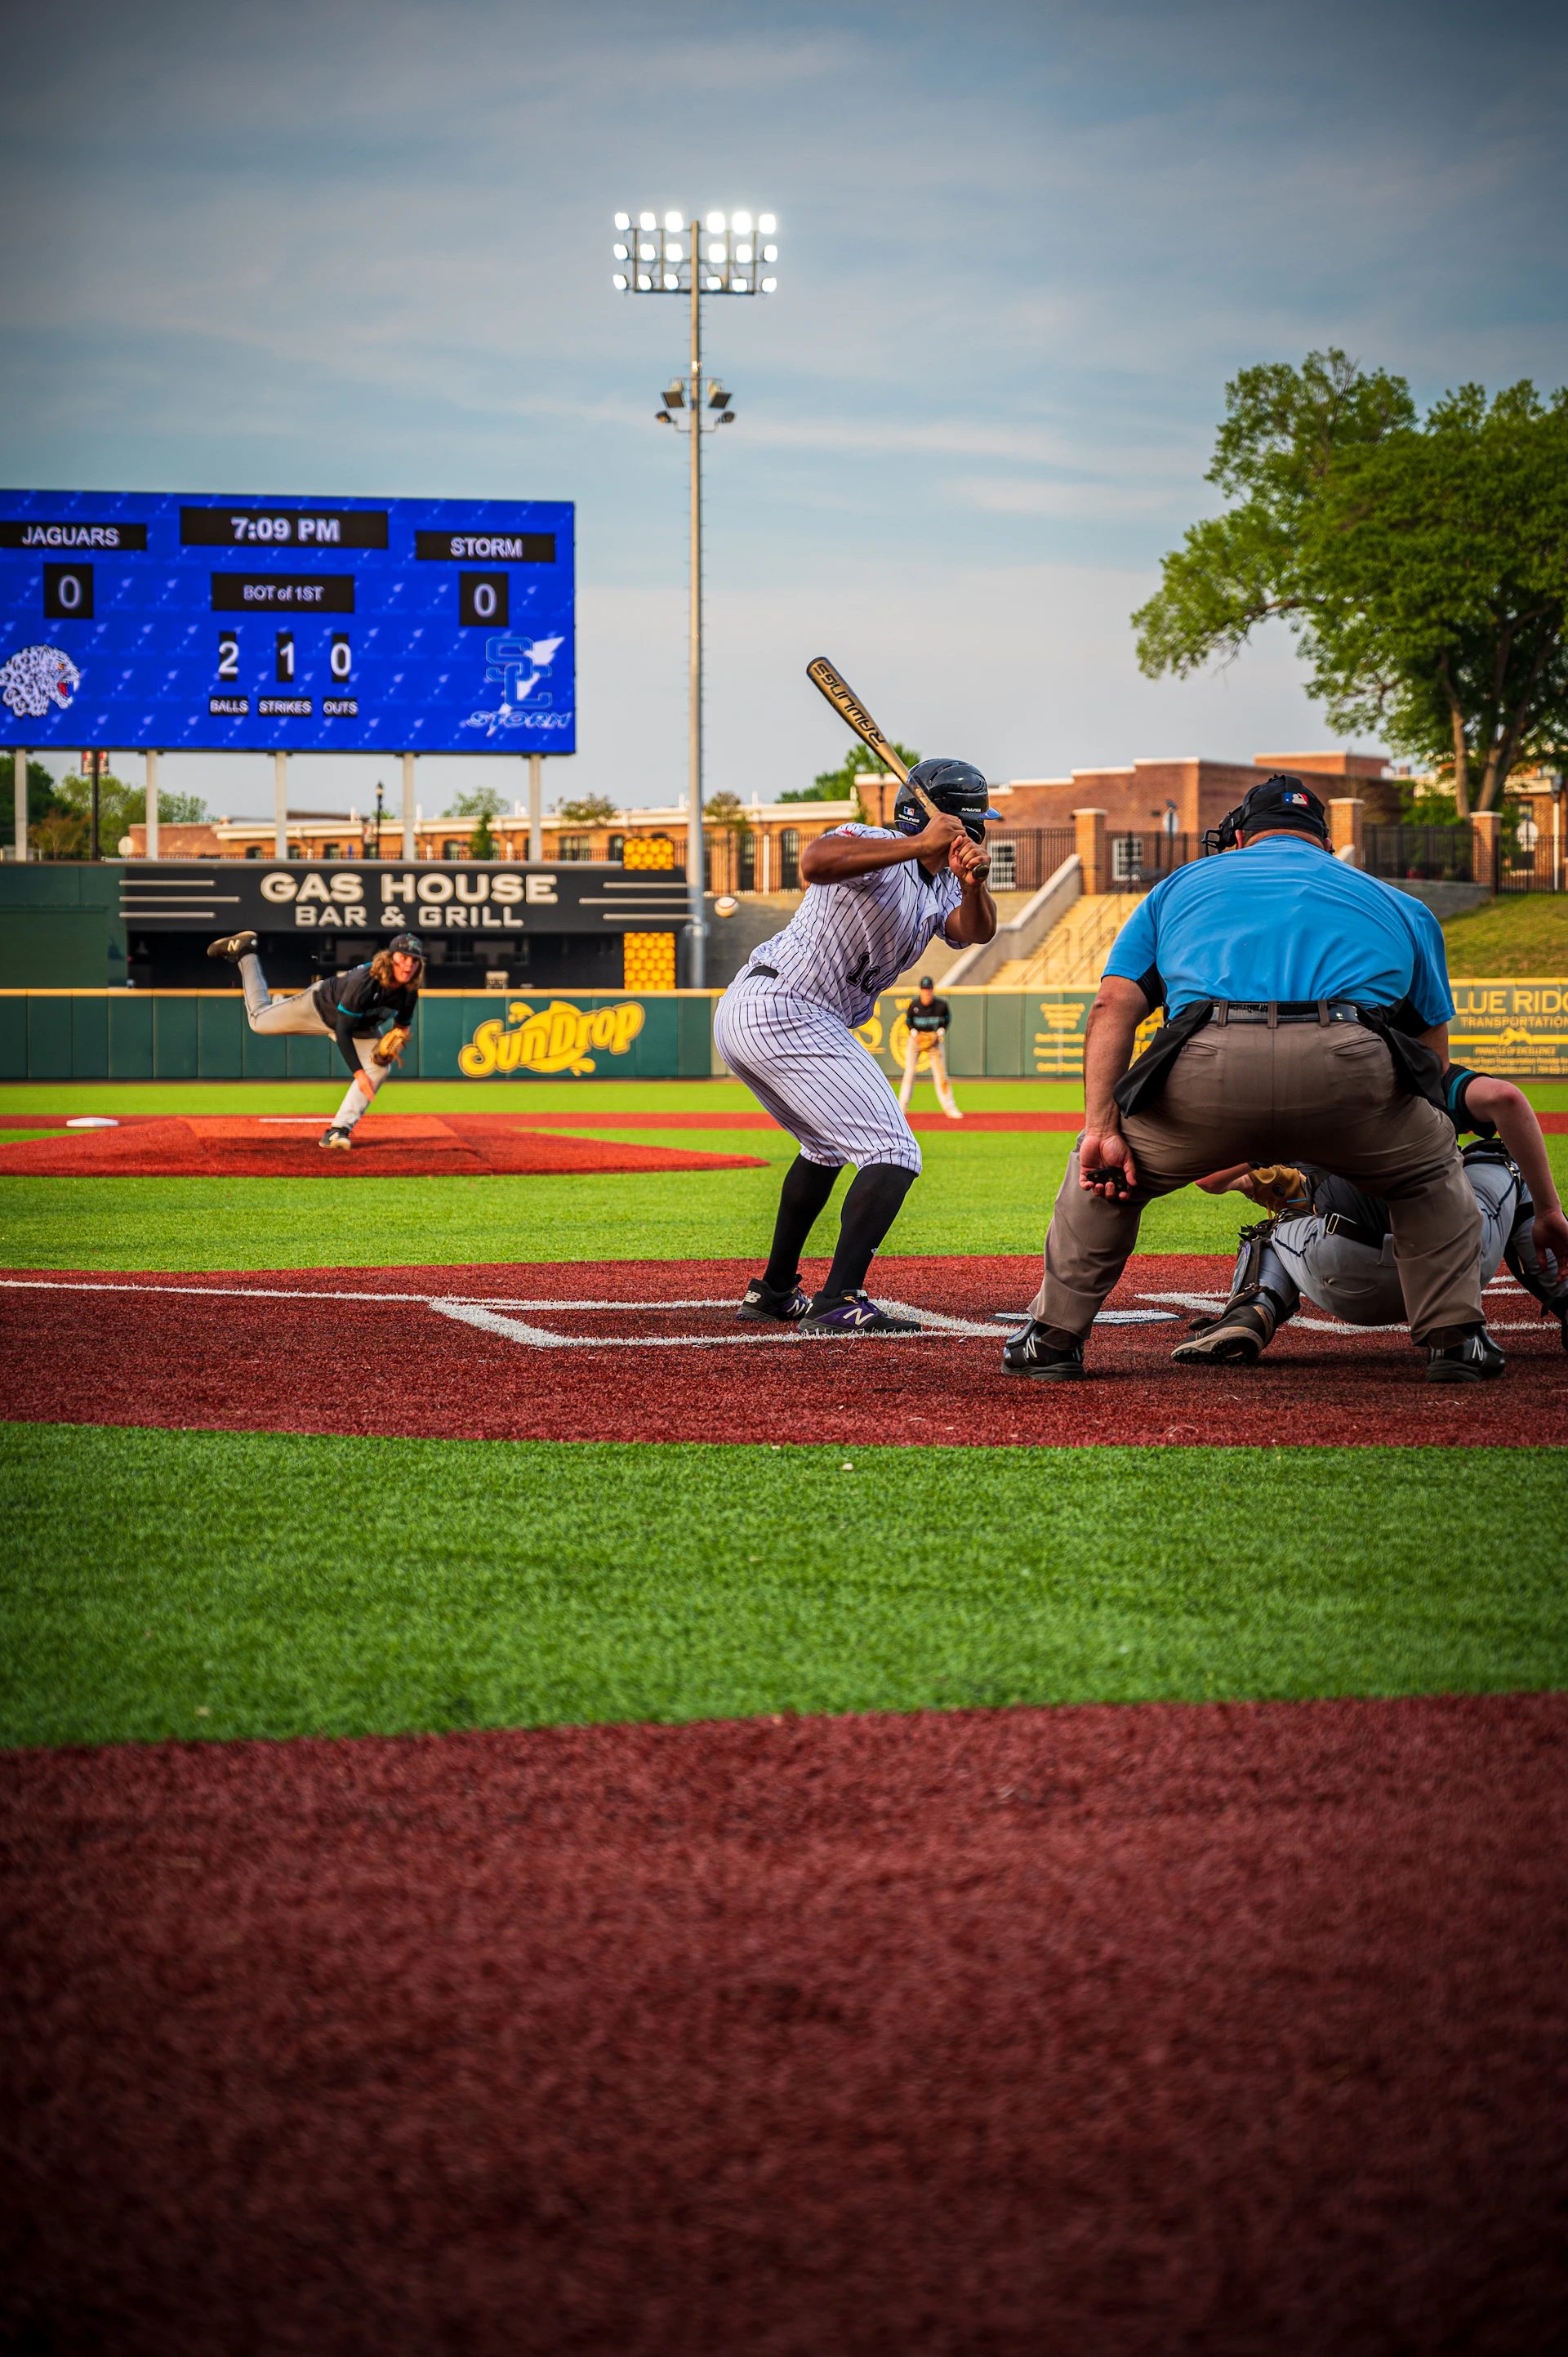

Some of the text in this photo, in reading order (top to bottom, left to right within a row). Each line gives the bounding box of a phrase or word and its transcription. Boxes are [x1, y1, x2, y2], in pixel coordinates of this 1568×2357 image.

[22, 527, 121, 547] JAGUARS
[231, 517, 341, 542] 7:09 PM
[450, 537, 523, 558] STORM
[58, 574, 82, 609] 0
[243, 585, 325, 601] BOT of 1ST
[474, 583, 497, 617] 0
[218, 641, 239, 675] 2
[279, 641, 295, 675] 1
[330, 643, 352, 677] 0
[209, 700, 358, 715] BALLS STRIKES OUTS
[813, 663, 886, 747] RAWLINGS
[466, 711, 572, 729] STORM
[261, 872, 558, 904] GAS HOUSE
[295, 906, 523, 928] BAR & GRILL
[1451, 990, 1568, 1014] LUE RID
